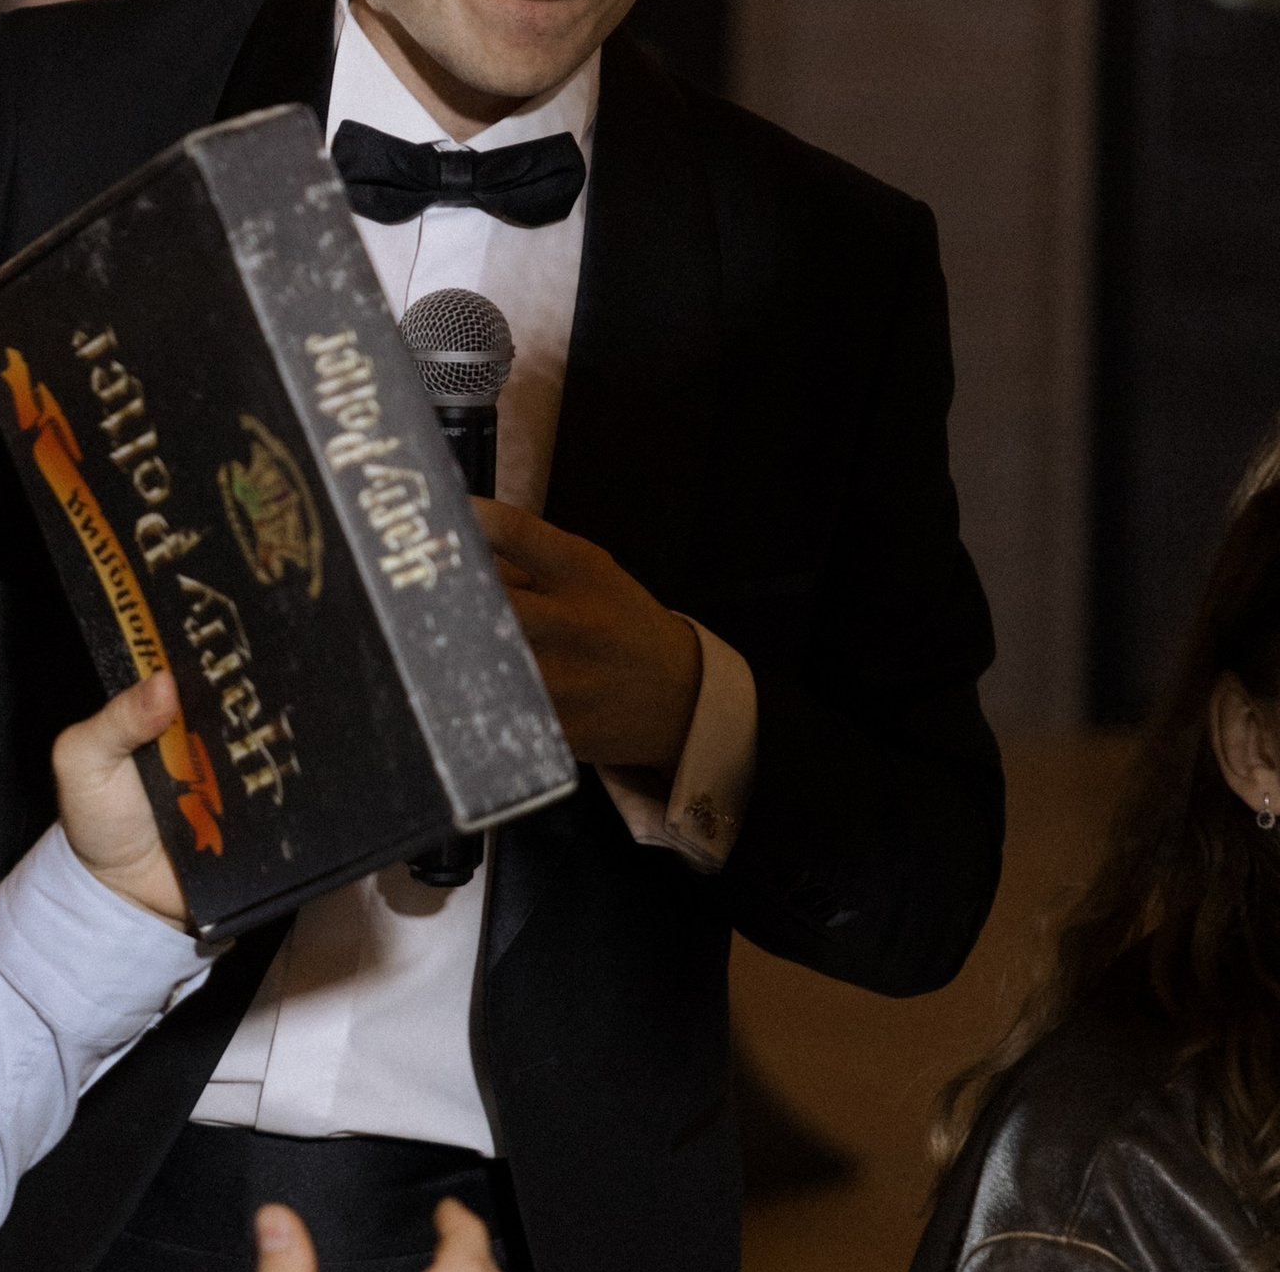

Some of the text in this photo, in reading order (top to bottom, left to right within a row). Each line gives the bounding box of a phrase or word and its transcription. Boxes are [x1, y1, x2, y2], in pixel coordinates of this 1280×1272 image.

[71, 326, 302, 806] Harry Potter
[304, 328, 462, 591] Harry Potter
